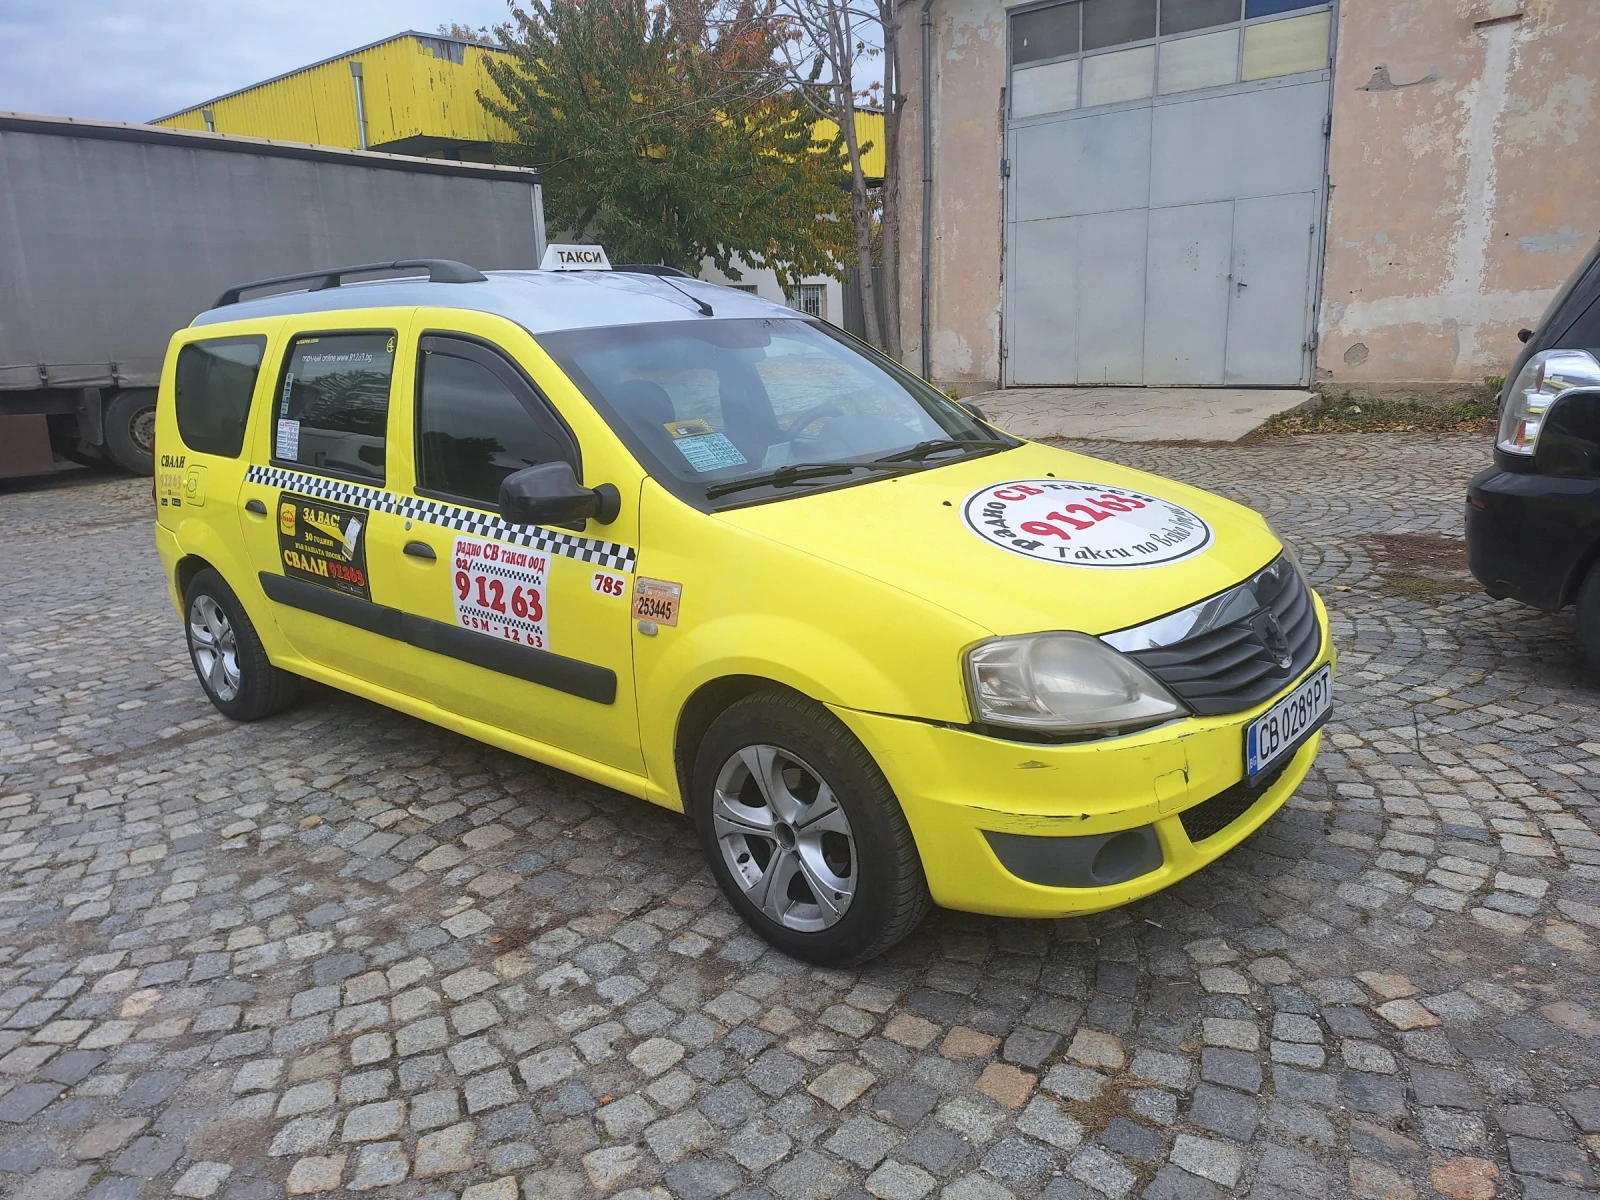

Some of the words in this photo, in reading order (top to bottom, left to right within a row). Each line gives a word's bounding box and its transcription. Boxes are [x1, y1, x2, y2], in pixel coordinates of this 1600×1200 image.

[557, 251, 602, 263] ТАКСИ
[161, 455, 186, 468] СВАЛИ
[302, 507, 316, 522] ЗА
[317, 510, 341, 528] ВАС!
[1020, 493, 1147, 541] 91263
[304, 531, 313, 541] 30
[1131, 541, 1159, 555] по
[283, 549, 329, 578] СВАЛИ
[328, 561, 365, 587] 91263
[501, 549, 528, 567] такси
[528, 556, 546, 576] оод
[594, 573, 624, 597] 785
[637, 596, 672, 620] 253445
[1249, 755, 1257, 769] BG
